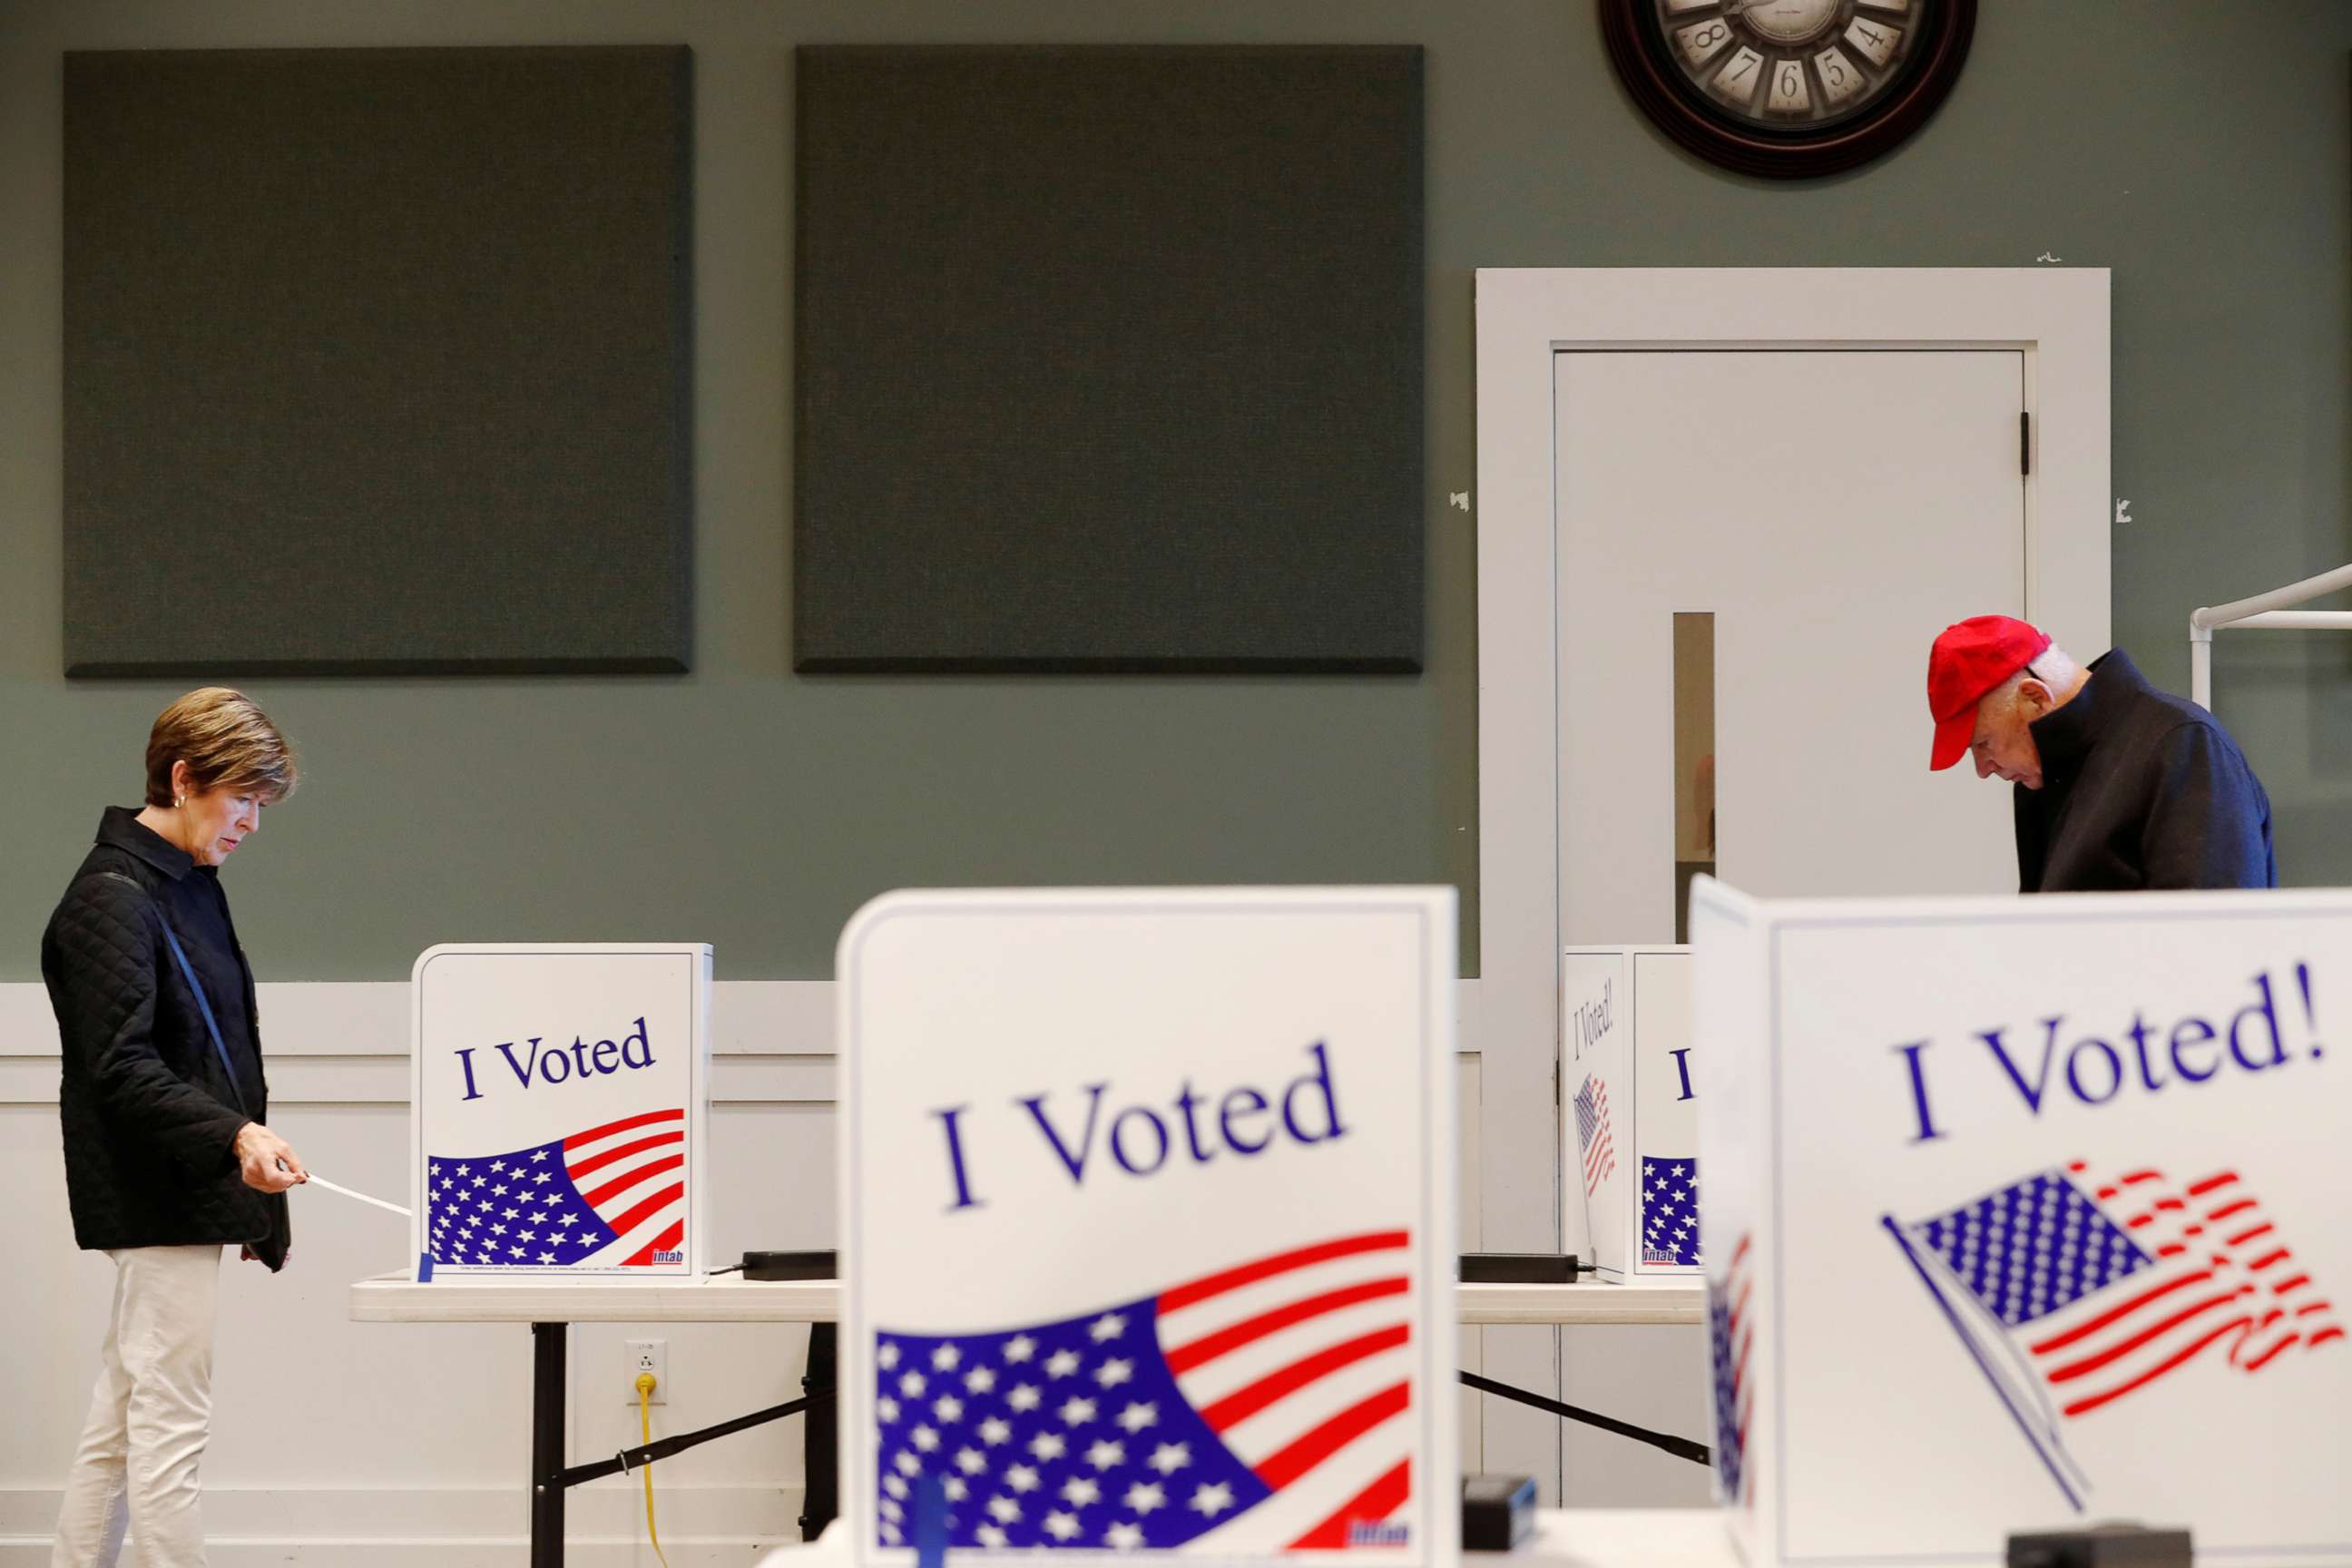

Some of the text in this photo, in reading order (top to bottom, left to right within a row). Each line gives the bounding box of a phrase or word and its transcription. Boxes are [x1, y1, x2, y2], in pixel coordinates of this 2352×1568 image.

[1695, 24, 1726, 48] 8
[1857, 25, 1885, 47] 4
[1731, 53, 1757, 82] 7
[1780, 64, 1798, 98] 6
[1823, 54, 1845, 86] 5
[1581, 976, 1612, 1049] Voted!
[455, 1016, 657, 1101] I Voted
[1893, 959, 2325, 1146] I Voted!
[1669, 1047, 1698, 1101] I
[931, 1040, 1350, 1212] I Voted
[653, 1248, 683, 1262] intab
[1643, 1248, 1675, 1262] intab
